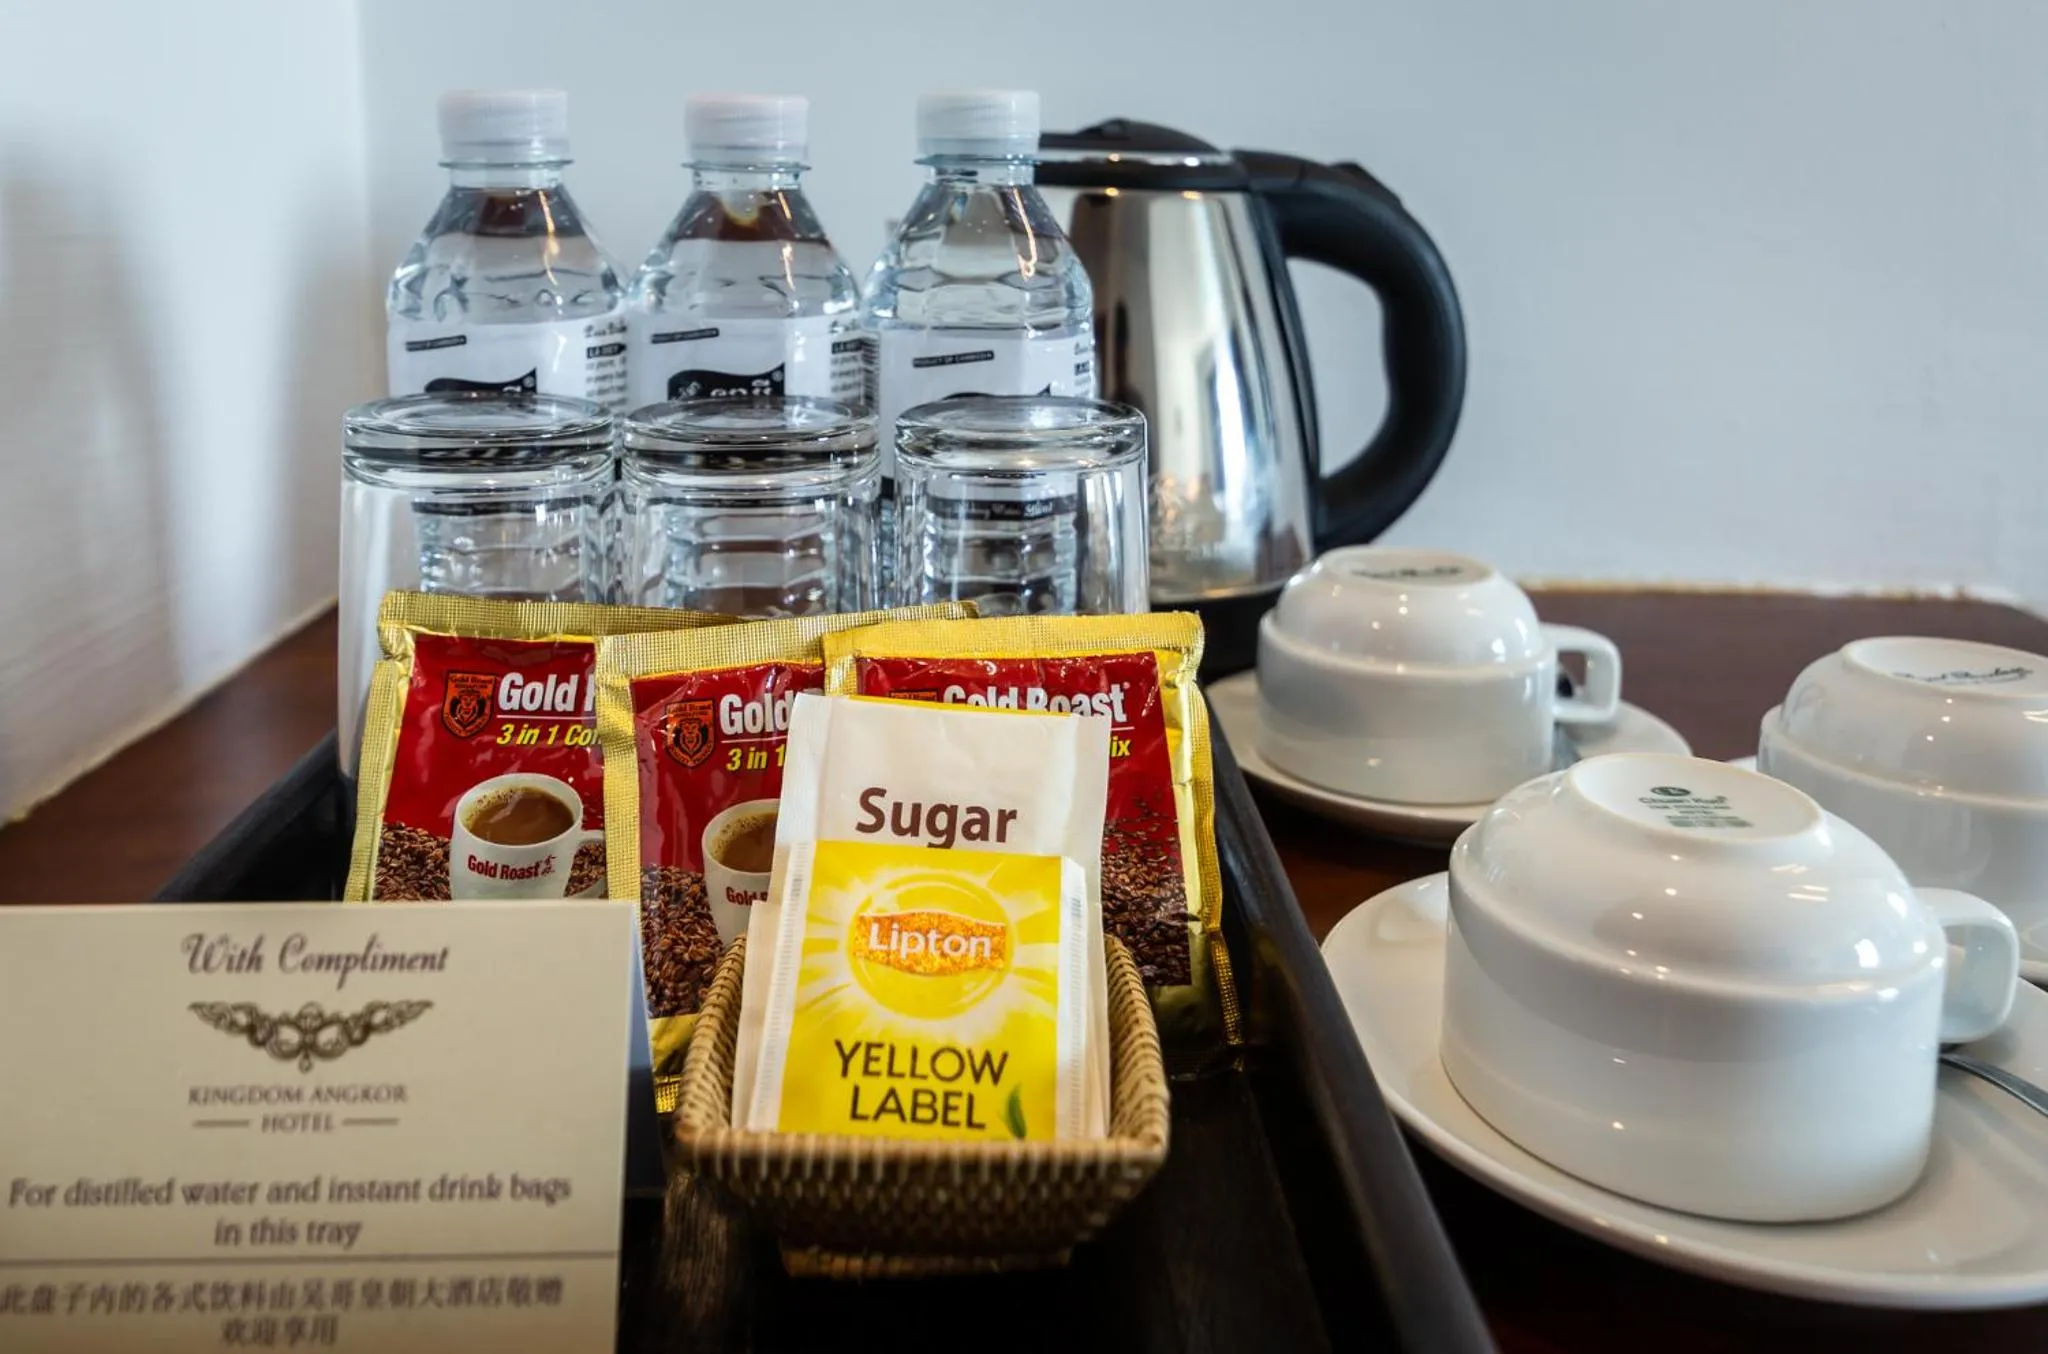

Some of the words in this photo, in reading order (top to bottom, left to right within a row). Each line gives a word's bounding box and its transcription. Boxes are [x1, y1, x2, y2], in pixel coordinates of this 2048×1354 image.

[498, 672, 579, 712] Gold
[1026, 683, 1127, 723] Roast
[720, 690, 794, 735] Gold
[496, 723, 515, 745] 3
[516, 723, 540, 745] in
[546, 724, 560, 745] 1
[1110, 736, 1131, 758] ix
[726, 747, 742, 772] 3
[746, 746, 768, 770] in
[775, 743, 786, 767] 1
[855, 786, 1018, 849] Sugar
[467, 854, 498, 878] Gold
[500, 860, 542, 880] Roast
[867, 921, 993, 960] Lipton
[182, 933, 265, 975] With
[277, 932, 450, 991] Compliment
[833, 1038, 1009, 1087] YELLOW
[188, 1084, 303, 1106] KINGDOM
[308, 1083, 408, 1104] ANGKOR
[848, 1084, 987, 1131] LABEL
[260, 1112, 334, 1134] HOTEL
[9, 1177, 57, 1209] For
[63, 1177, 176, 1208] distilled
[181, 1181, 260, 1206] water
[266, 1175, 322, 1205] and
[327, 1176, 422, 1204] instant
[427, 1172, 504, 1203] drink
[509, 1172, 572, 1208] bags
[214, 1218, 242, 1247] in
[249, 1216, 299, 1246] this
[306, 1219, 363, 1250] tray
